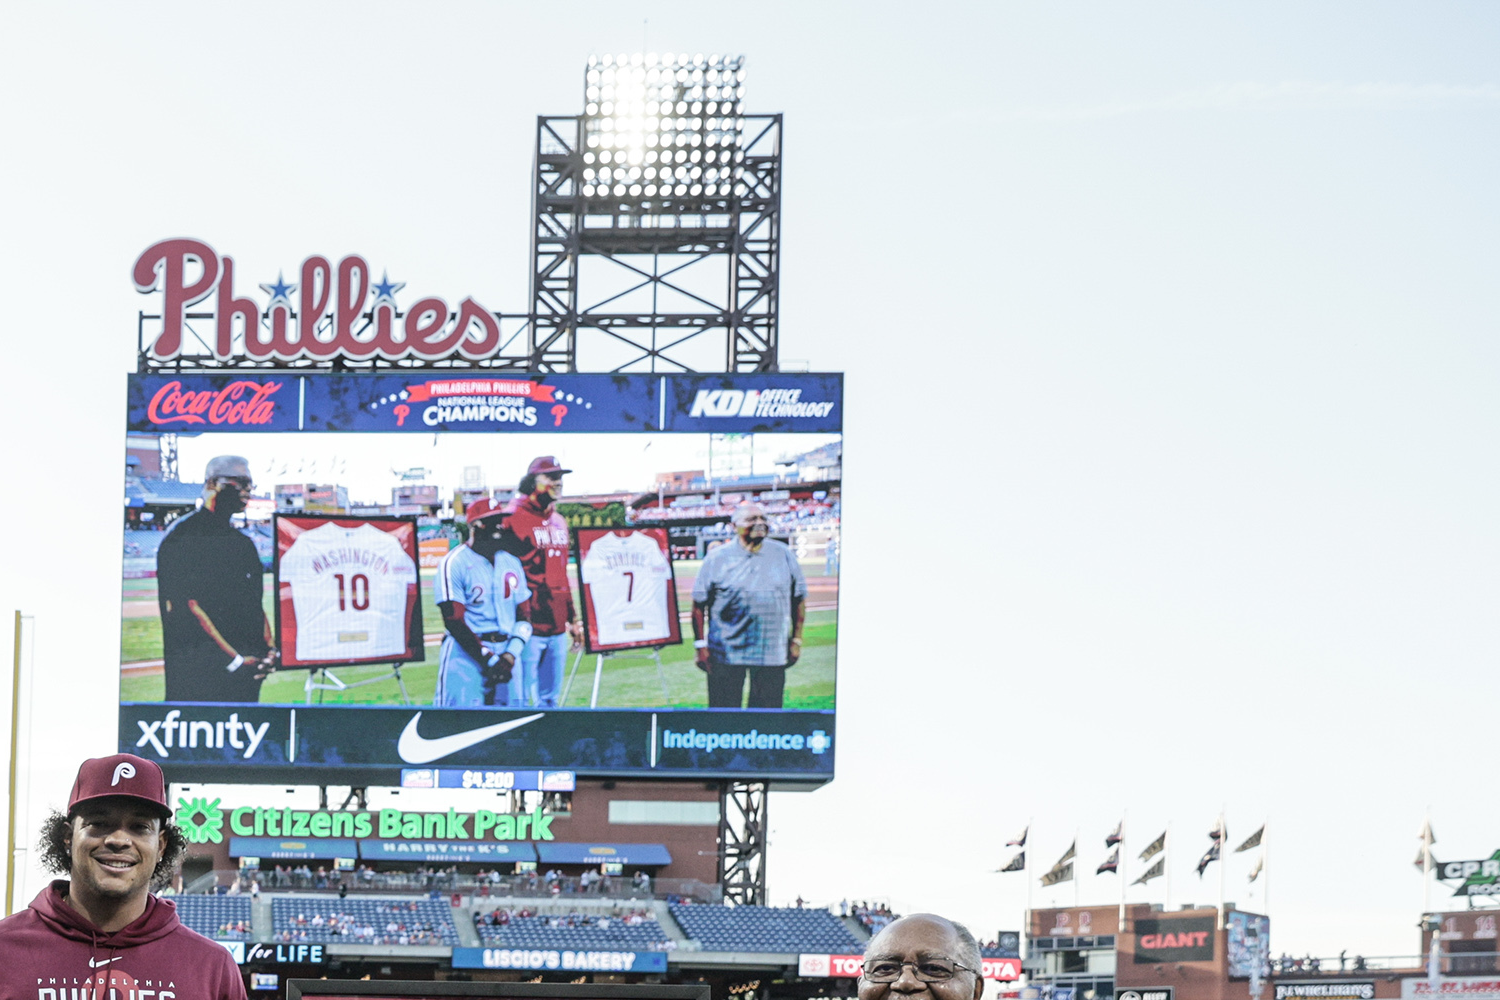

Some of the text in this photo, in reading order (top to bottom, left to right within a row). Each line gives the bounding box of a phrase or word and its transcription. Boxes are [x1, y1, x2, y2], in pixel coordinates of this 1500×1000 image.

[132, 236, 501, 361] Phillies
[430, 382, 531, 395] PHILADELPHIA PHILLIES
[760, 389, 802, 403] OFFICE
[437, 396, 525, 408] NATIONAL LEAGUE
[756, 402, 835, 418] TECHNOLOGY
[422, 404, 538, 427] CHAMPIONS
[334, 573, 370, 612] 10
[136, 710, 270, 759] xfinity
[663, 729, 804, 752] Independence
[230, 806, 555, 841] Citizens Bank Park
[383, 842, 449, 853] HARRY
[1140, 931, 1209, 949] GIANT
[246, 943, 273, 962] for
[276, 945, 322, 962] LIFE
[482, 949, 636, 970] LISCIO'S BAKERY
[37, 977, 176, 988] PHILADELPHIA
